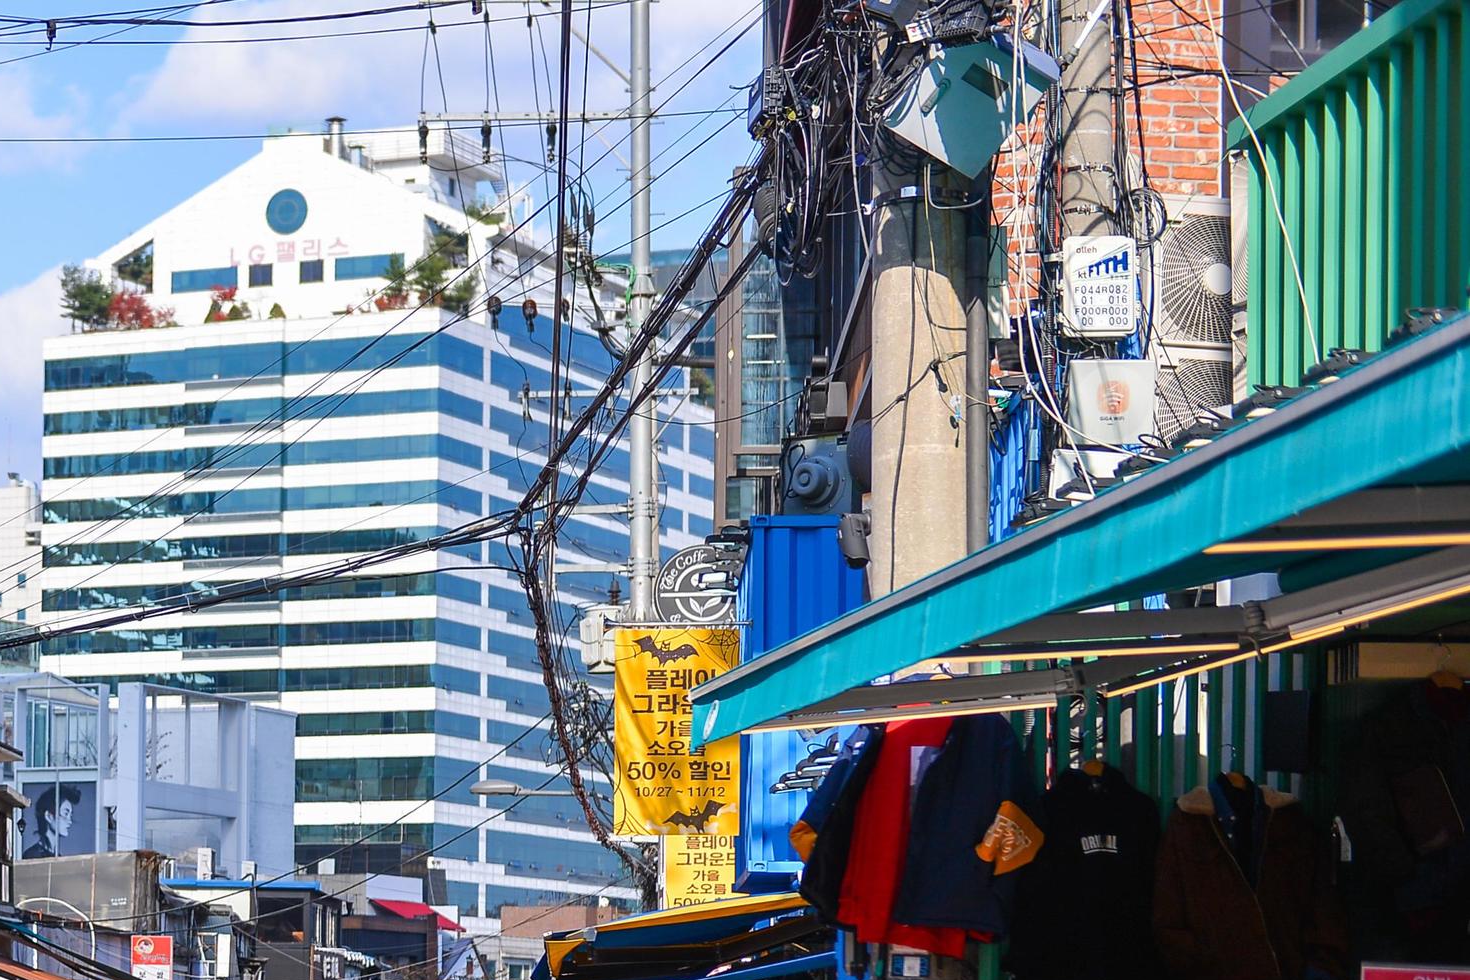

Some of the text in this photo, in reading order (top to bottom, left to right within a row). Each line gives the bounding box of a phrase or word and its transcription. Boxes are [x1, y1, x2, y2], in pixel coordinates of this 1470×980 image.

[230, 236, 349, 266] LG 팰리스
[1076, 246, 1098, 254] olleh
[1088, 251, 1128, 277] FTTH
[1109, 294, 1128, 304] 016
[627, 761, 731, 781] 50% 할인
[635, 787, 672, 797] 10/27
[688, 786, 725, 797] 11/12
[686, 835, 733, 849] 플레이
[676, 852, 735, 866] 그라운드
[693, 870, 719, 881] 가을
[686, 884, 726, 895] 소오름
